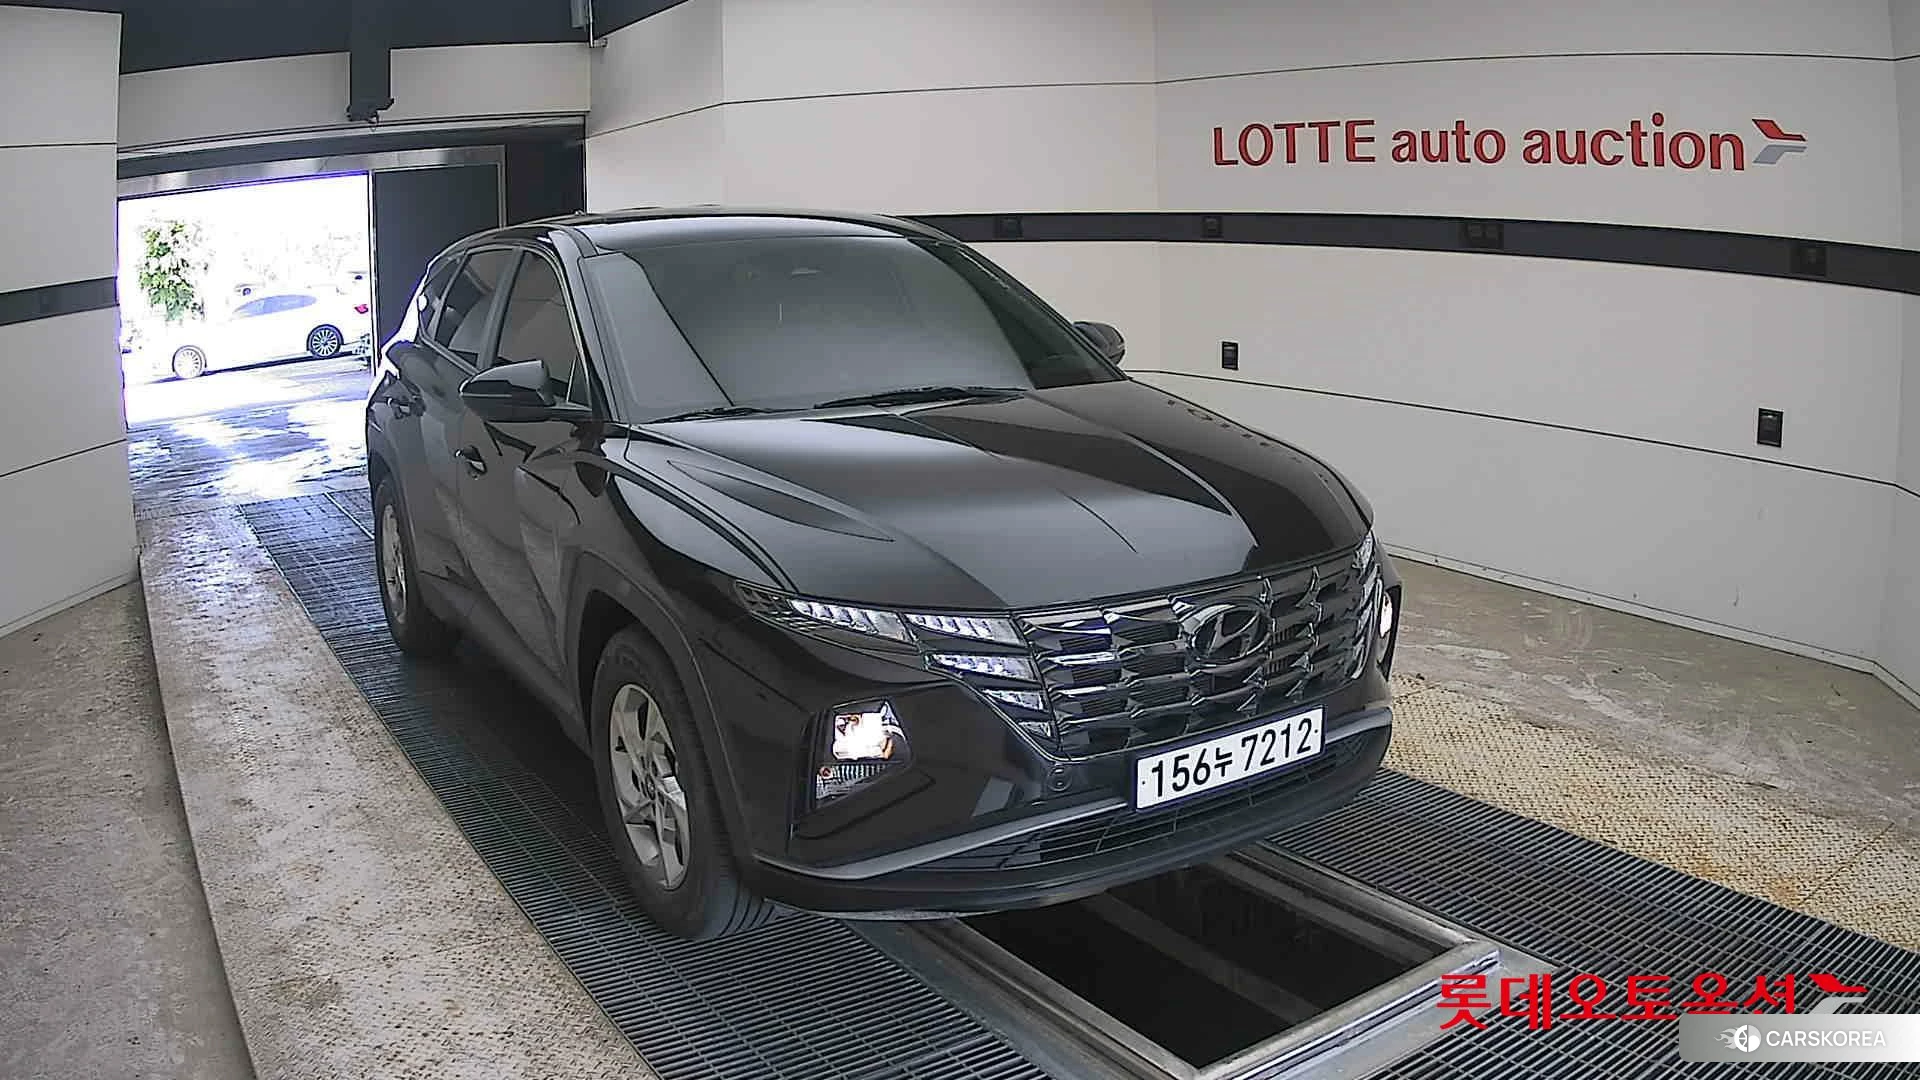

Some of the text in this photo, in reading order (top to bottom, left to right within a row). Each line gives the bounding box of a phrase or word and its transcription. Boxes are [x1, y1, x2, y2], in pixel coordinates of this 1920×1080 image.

[1213, 113, 1745, 171] LOTTE auto auction
[1151, 717, 1312, 797] 156누 7212
